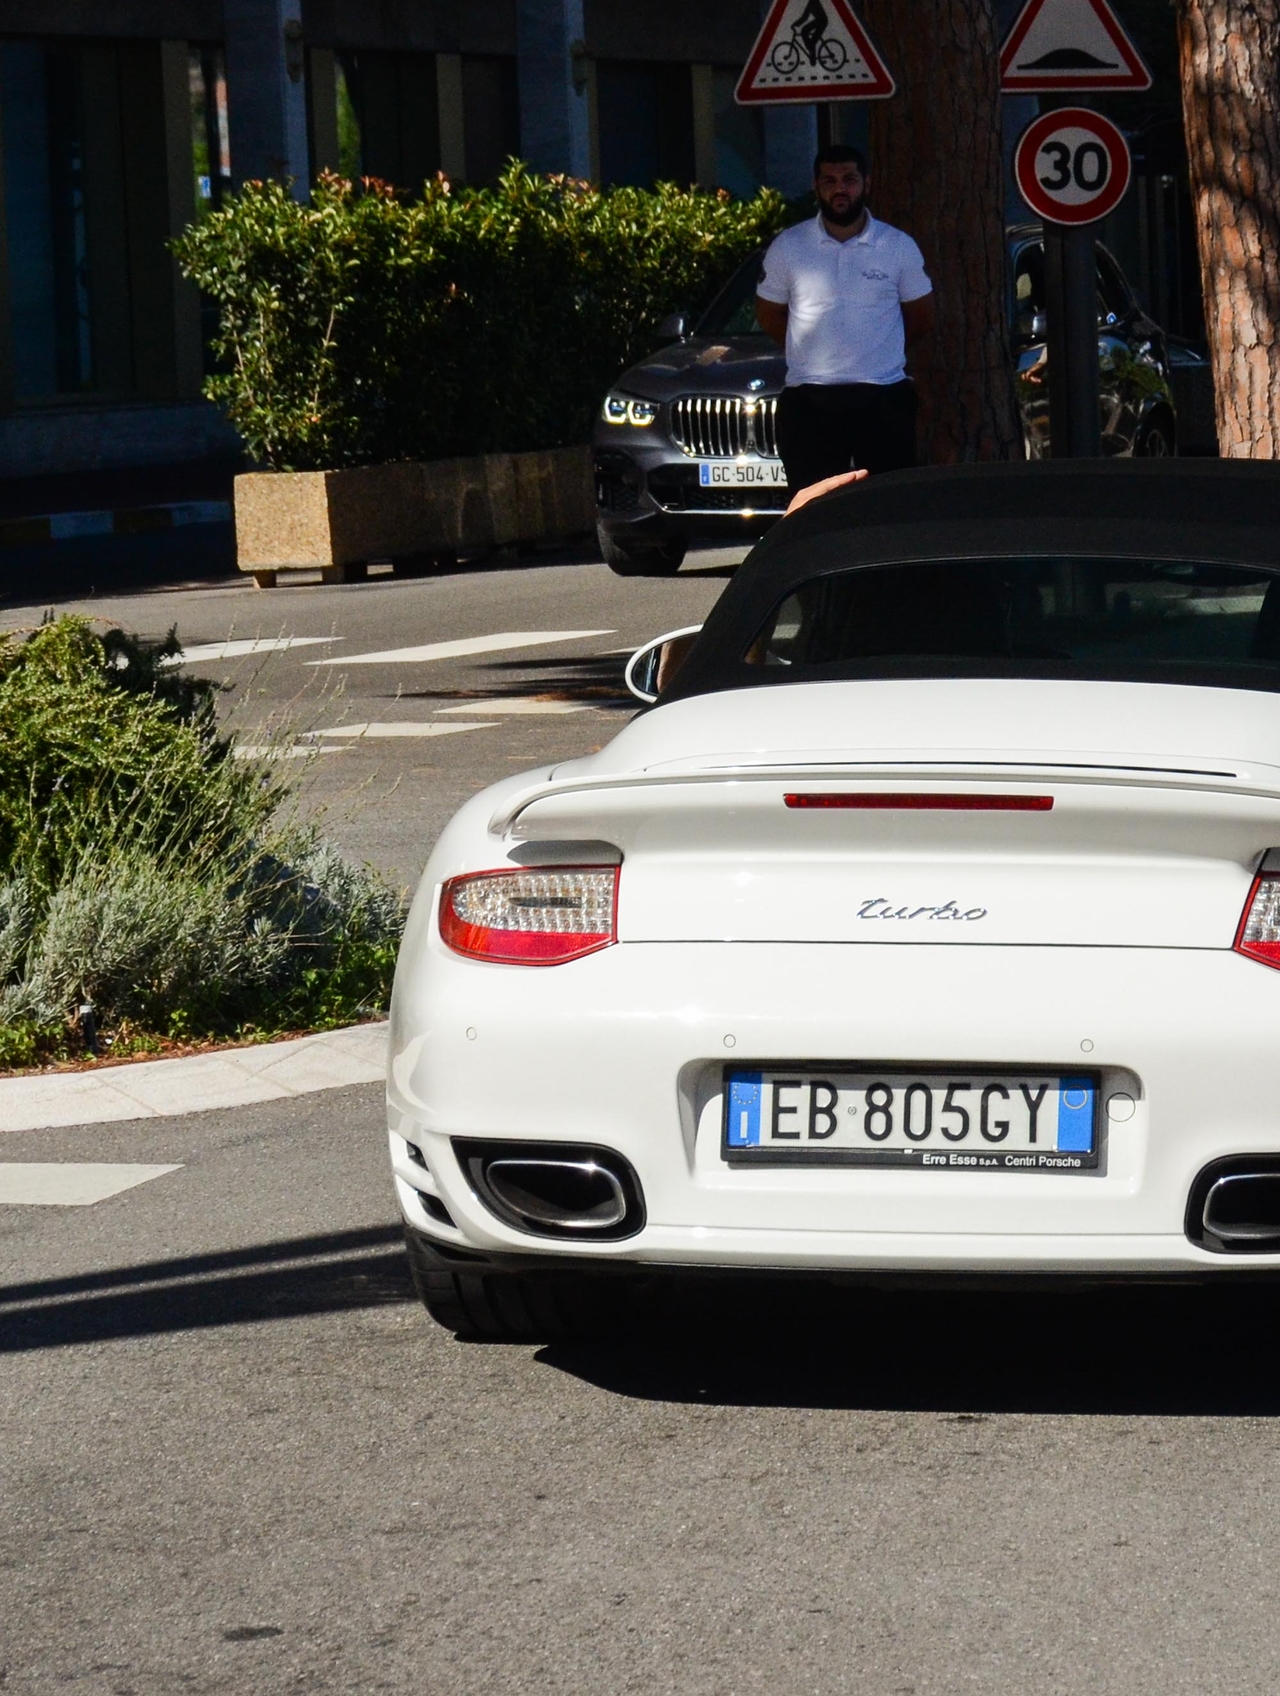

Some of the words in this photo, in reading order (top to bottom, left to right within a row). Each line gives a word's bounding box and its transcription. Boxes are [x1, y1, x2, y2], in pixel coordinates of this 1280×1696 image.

[1040, 141, 1107, 191] 30
[856, 897, 988, 921] turbo
[771, 1080, 839, 1140] EB
[864, 1082, 1049, 1144] 805GY
[922, 1154, 946, 1165] Erre
[949, 1154, 977, 1166] Esse
[1005, 1155, 1036, 1167] Centri
[1038, 1156, 1081, 1168] Porsche
